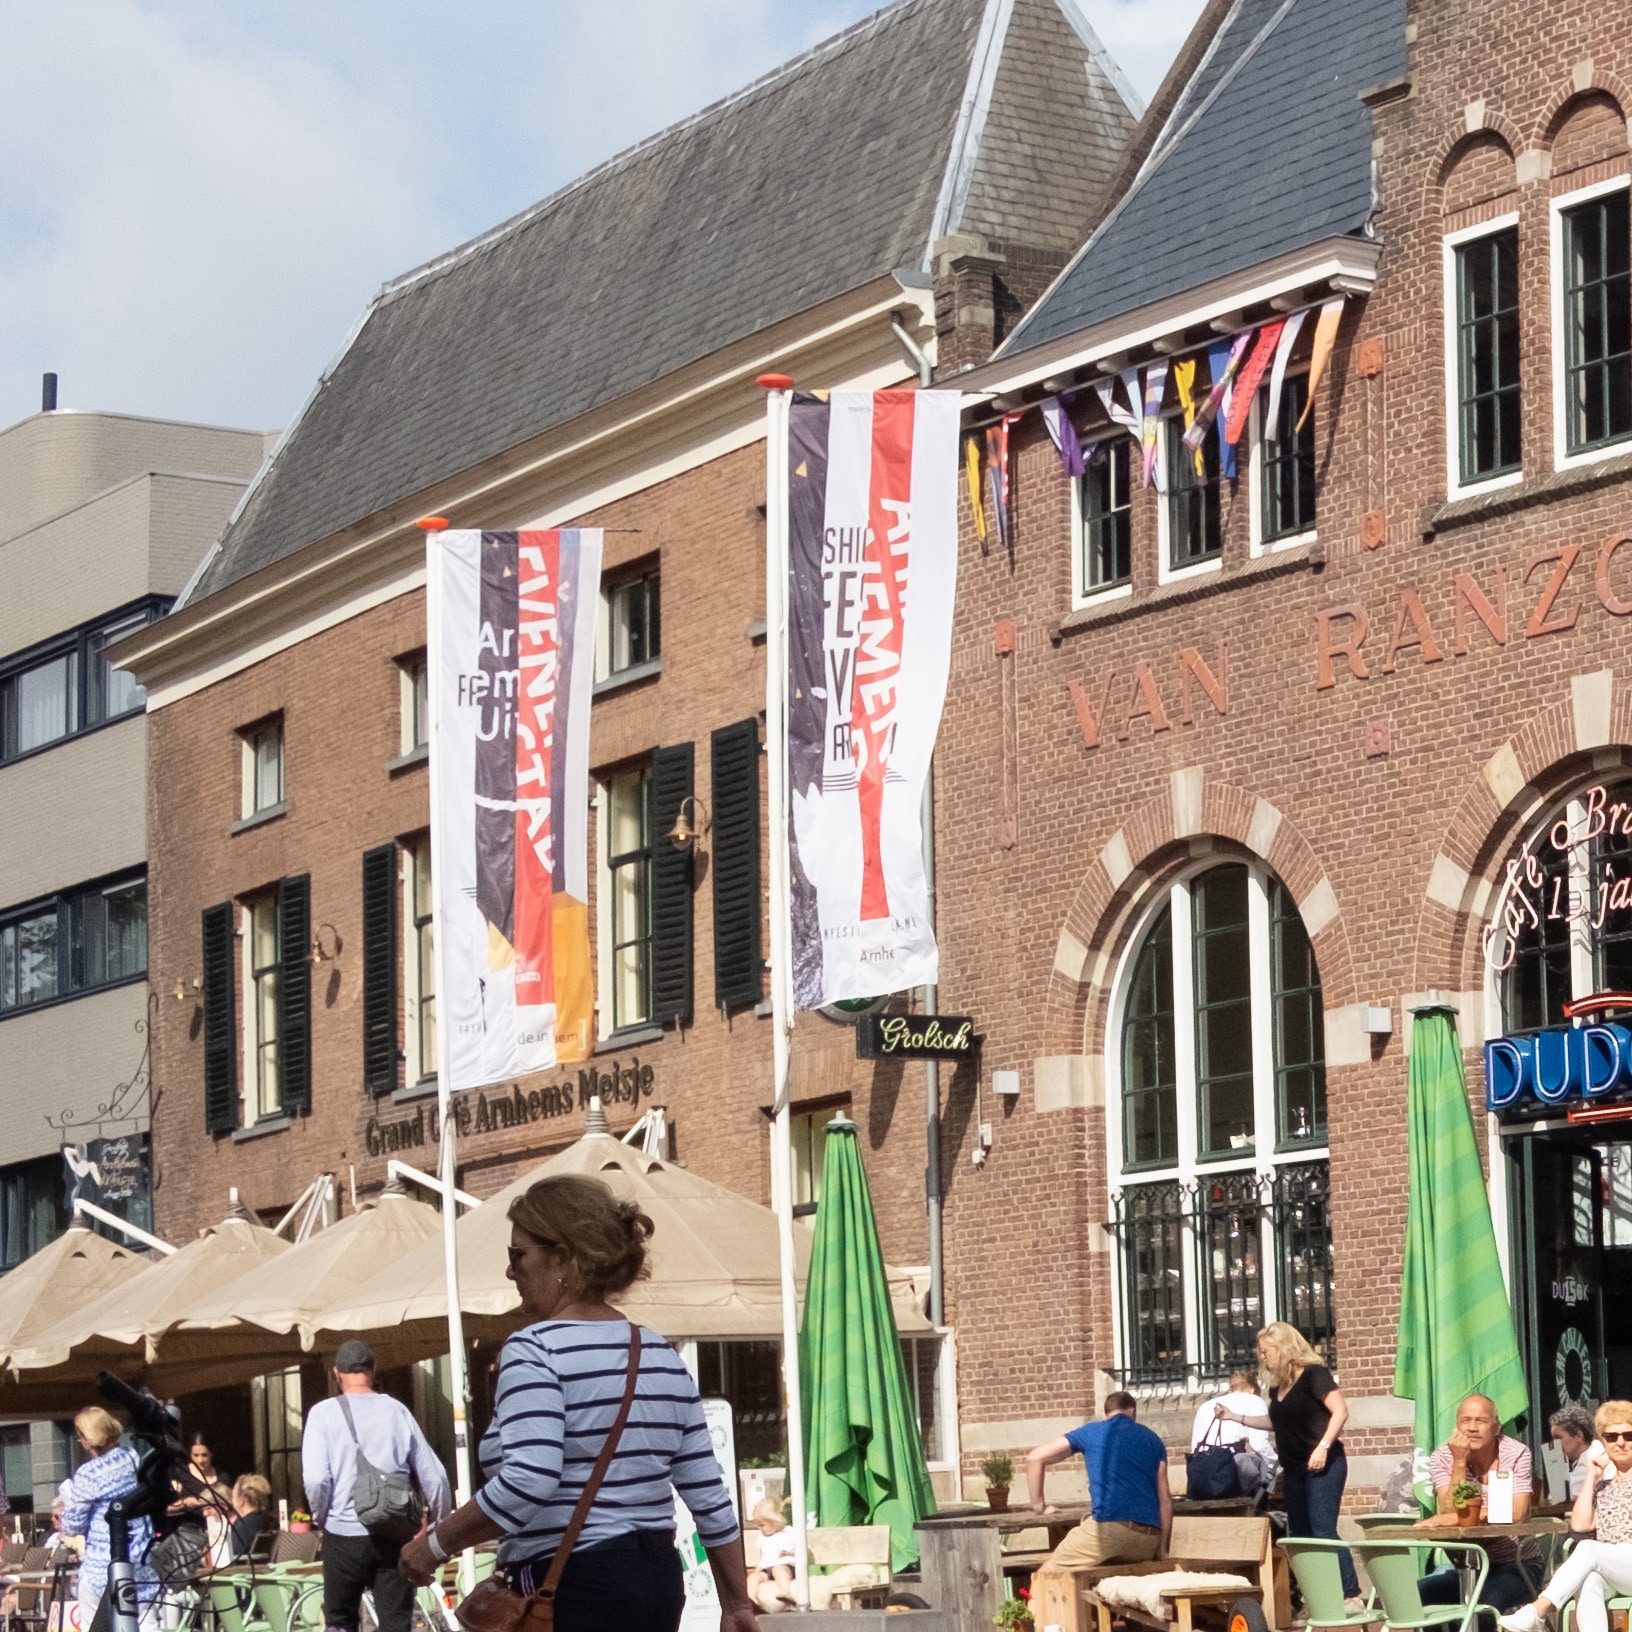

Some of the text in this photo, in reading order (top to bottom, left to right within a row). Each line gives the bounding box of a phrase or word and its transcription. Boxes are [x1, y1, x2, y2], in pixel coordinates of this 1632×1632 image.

[1066, 638, 1229, 749] VAN
[1482, 844, 1545, 972] Café
[880, 1017, 972, 1052] Grolsch
[366, 1057, 654, 1156] Grand Cfé Arnhems Meisje
